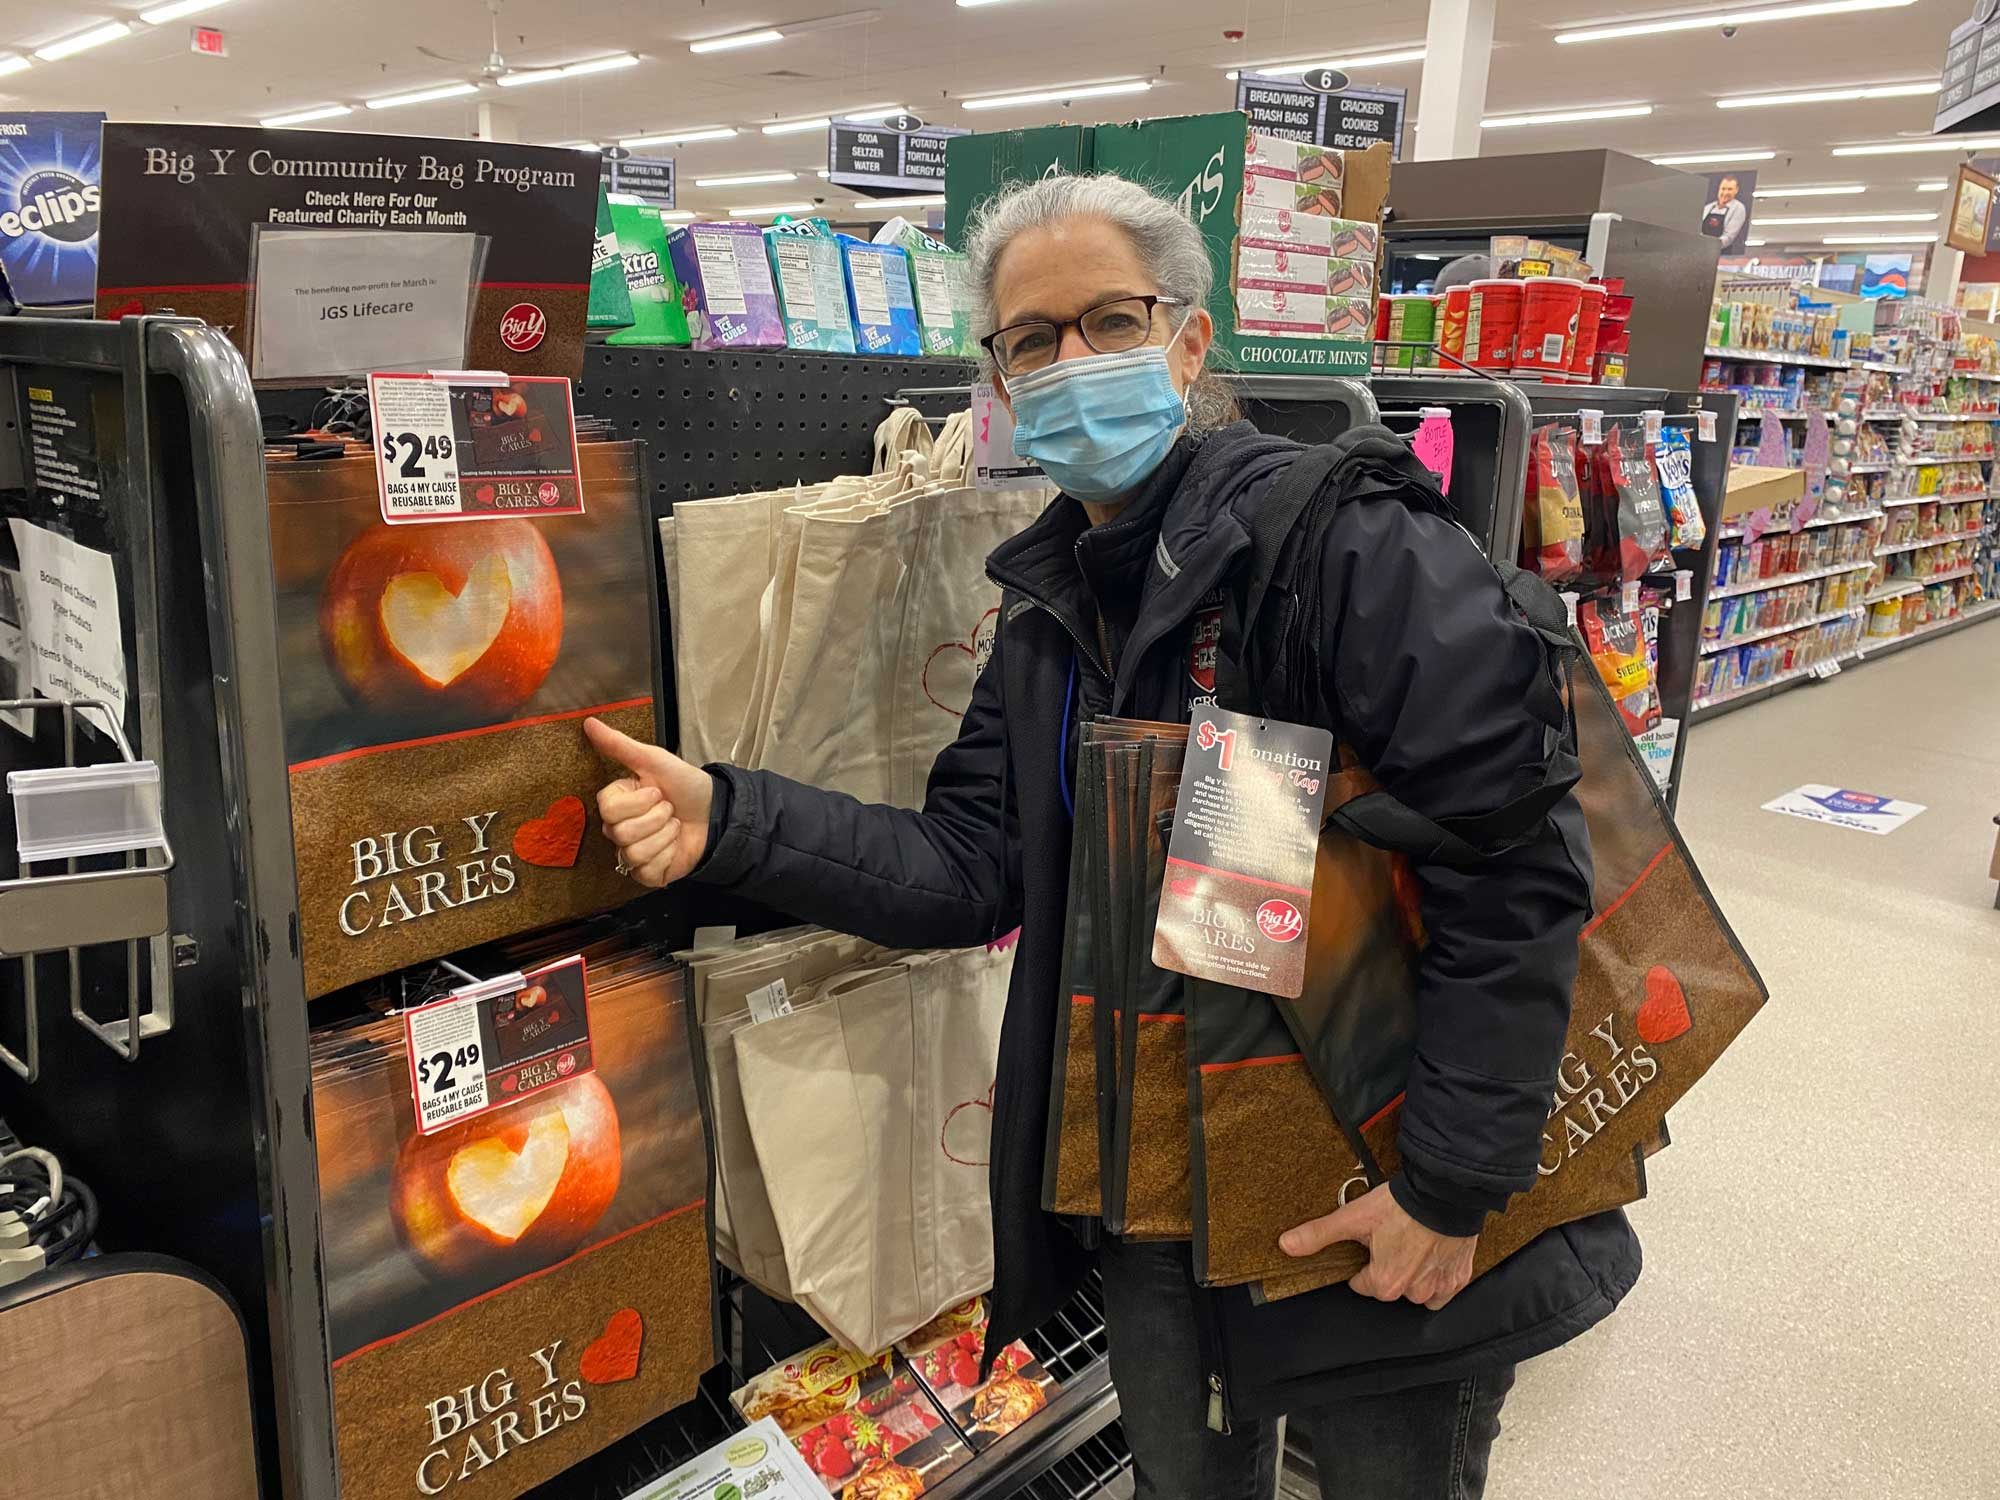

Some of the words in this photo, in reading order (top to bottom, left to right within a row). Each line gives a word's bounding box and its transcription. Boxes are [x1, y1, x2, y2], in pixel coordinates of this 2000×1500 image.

[1320, 71, 1332, 89] 6
[1250, 90, 1315, 108] BREAD/WRAPS
[1340, 99, 1385, 116] CRACKERS
[898, 116, 907, 130] 5
[1253, 108, 1282, 123] TRASH
[1284, 111, 1309, 125] BAGS
[1341, 117, 1379, 132] COOKIES
[857, 133, 878, 144] SODA
[1272, 127, 1313, 143] STORAGE
[1334, 133, 1354, 147] RICE
[609, 147, 618, 158] 4
[851, 146, 884, 158] SELTZER
[910, 138, 938, 150] POTATO
[906, 151, 940, 162] TORTILLA
[144, 147, 195, 184] Big
[207, 149, 237, 175] Y
[248, 149, 407, 184] Community
[417, 155, 464, 190] Bag
[474, 159, 576, 193] Program
[854, 160, 880, 172] WATER
[906, 164, 934, 176] ENERGY
[305, 190, 349, 206] Check
[354, 192, 385, 207] Here
[389, 193, 412, 208] For
[413, 193, 438, 208] Our
[0, 184, 100, 237] eclips
[268, 208, 333, 223] Featured
[337, 209, 387, 227] Charity
[390, 210, 422, 225] Each
[426, 211, 467, 226] Month
[621, 251, 659, 275] xtra
[295, 288, 309, 296] The
[311, 284, 350, 295] benefiting
[351, 281, 389, 293] non-profit
[390, 280, 401, 289] for
[402, 278, 427, 288] March
[627, 273, 665, 291] reshers
[320, 305, 348, 321] JGS
[353, 301, 414, 317] Lifecare
[718, 319, 733, 335] ICE
[721, 323, 748, 343] CUBES
[794, 329, 819, 347] CUBES
[868, 333, 891, 350] CUBES
[1240, 345, 1326, 365] CHOCOLATE
[1327, 349, 1368, 366] MINTS
[500, 440, 532, 453] CARES
[501, 435, 519, 445] BIG
[387, 482, 409, 494] BAGS
[410, 482, 416, 493] 4
[417, 481, 430, 493] MY
[431, 481, 457, 493] CAUSE
[499, 484, 520, 495] BIG
[525, 482, 534, 494] Y
[392, 494, 433, 507] REUSABLE
[434, 494, 455, 506] BAGS
[495, 495, 539, 508] CARES
[40, 569, 63, 592] Bounty
[73, 586, 97, 609] Charmin
[69, 609, 92, 632] Products
[1641, 733, 1654, 742] old
[1655, 731, 1675, 741] house
[1197, 720, 1237, 771] $1
[1648, 747, 1673, 760] vibes
[1193, 780, 1225, 794] difference
[1204, 775, 1215, 785] Big
[1288, 769, 1320, 796] Tag
[1191, 797, 1220, 809] purchase
[1194, 789, 1208, 798] and
[1207, 793, 1224, 802] work
[1183, 818, 1213, 831] diligently
[1187, 811, 1216, 824] donation
[1202, 831, 1214, 839] call
[348, 825, 446, 886] BIG
[461, 811, 499, 856] Y
[338, 854, 516, 936] CARES
[1192, 908, 1224, 929] BIG
[1239, 917, 1251, 934] Y
[1184, 924, 1256, 954] CARES
[1219, 955, 1245, 967] reverse
[1245, 959, 1259, 969] side
[1259, 964, 1271, 973] for
[1225, 964, 1268, 979] instructions.
[522, 1024, 551, 1042] CARES
[521, 1063, 541, 1079] BIG
[544, 1060, 554, 1073] Y
[1547, 1052, 1597, 1119] IG
[1588, 1012, 1624, 1061] Y
[517, 1071, 558, 1091] CARES
[422, 1097, 442, 1111] BAGS
[442, 1095, 447, 1103] 4
[448, 1090, 461, 1102] MY
[461, 1081, 484, 1097] CAUSE
[426, 1103, 463, 1121] REUSABLE
[464, 1095, 482, 1109] BAGS
[1536, 1044, 1657, 1176] CARES
[425, 1367, 518, 1446] BIG
[529, 1340, 562, 1389] Y
[415, 1381, 586, 1495] CARES
